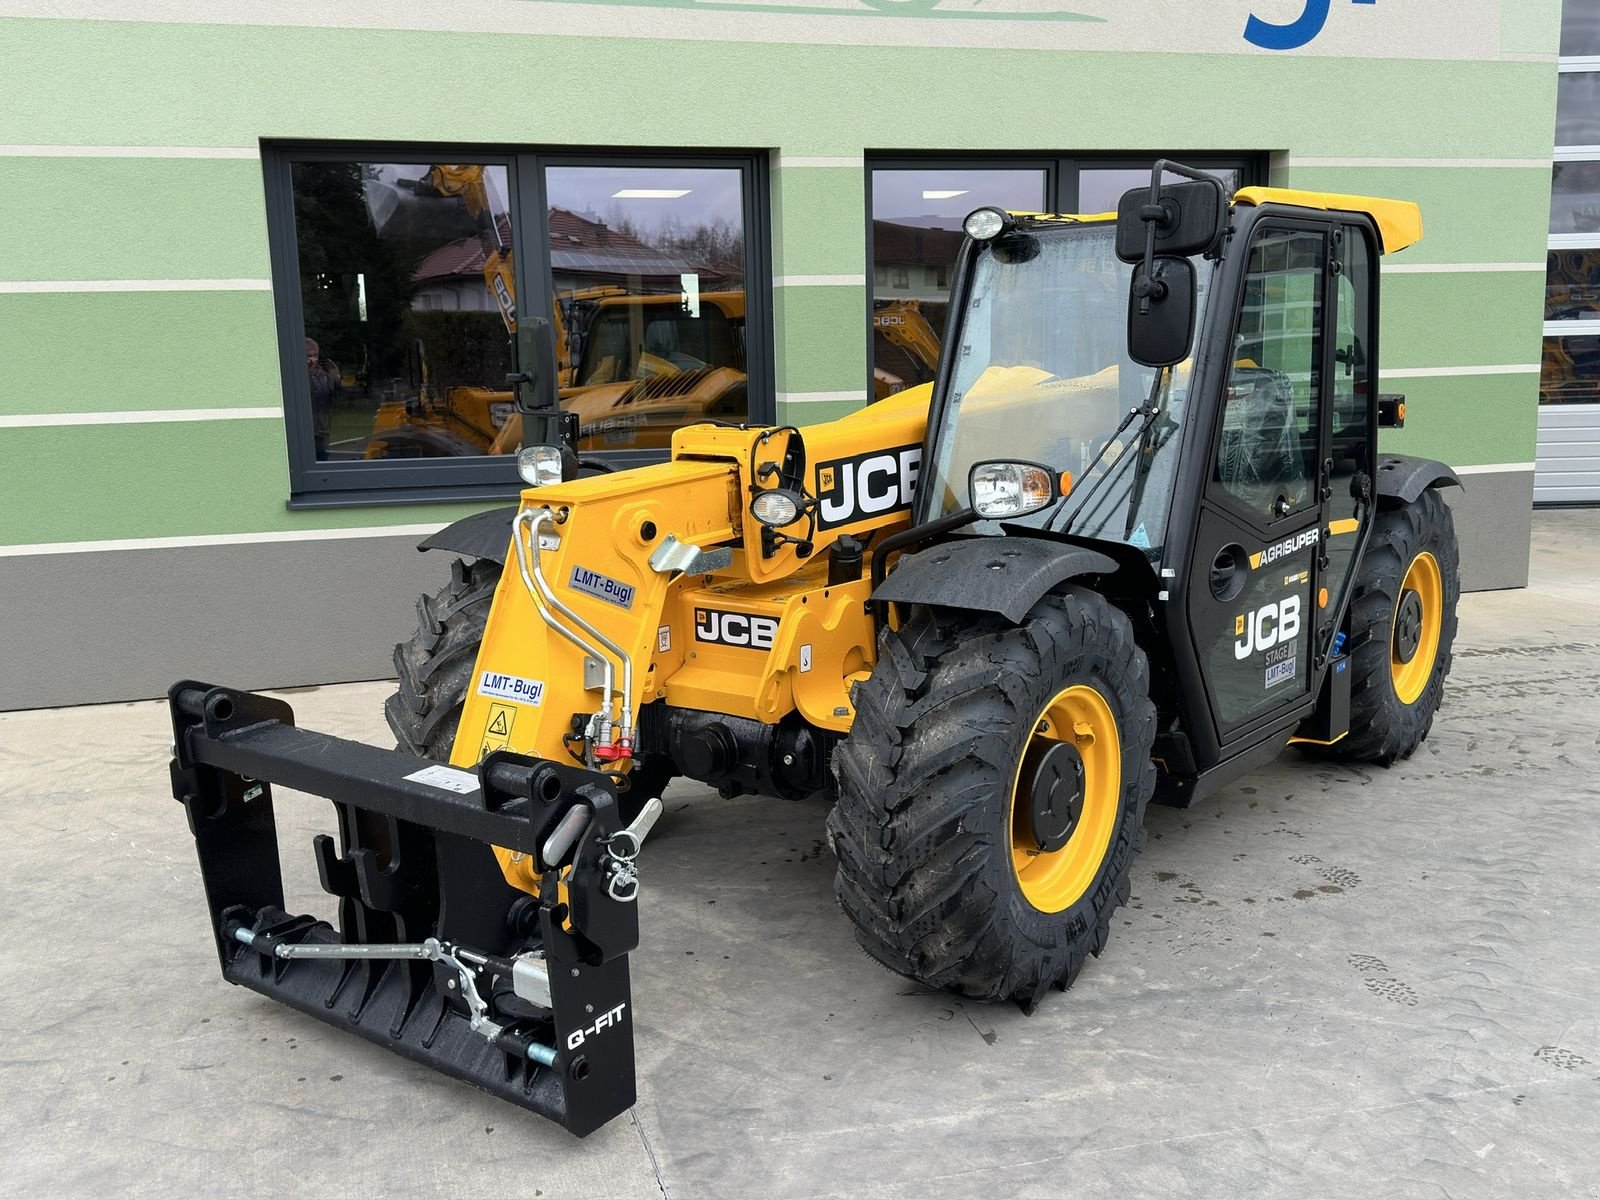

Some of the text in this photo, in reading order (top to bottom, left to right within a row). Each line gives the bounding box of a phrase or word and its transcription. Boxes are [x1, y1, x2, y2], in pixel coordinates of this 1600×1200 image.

[1260, 528, 1319, 567] AGRISUPER
[575, 568, 632, 602] LMT-Bugl
[697, 612, 778, 648] JCB
[1235, 594, 1300, 660] JCB
[1266, 645, 1288, 666] STAGE
[484, 673, 542, 699] LMT-Bugl
[568, 1002, 626, 1050] Q-FIT
